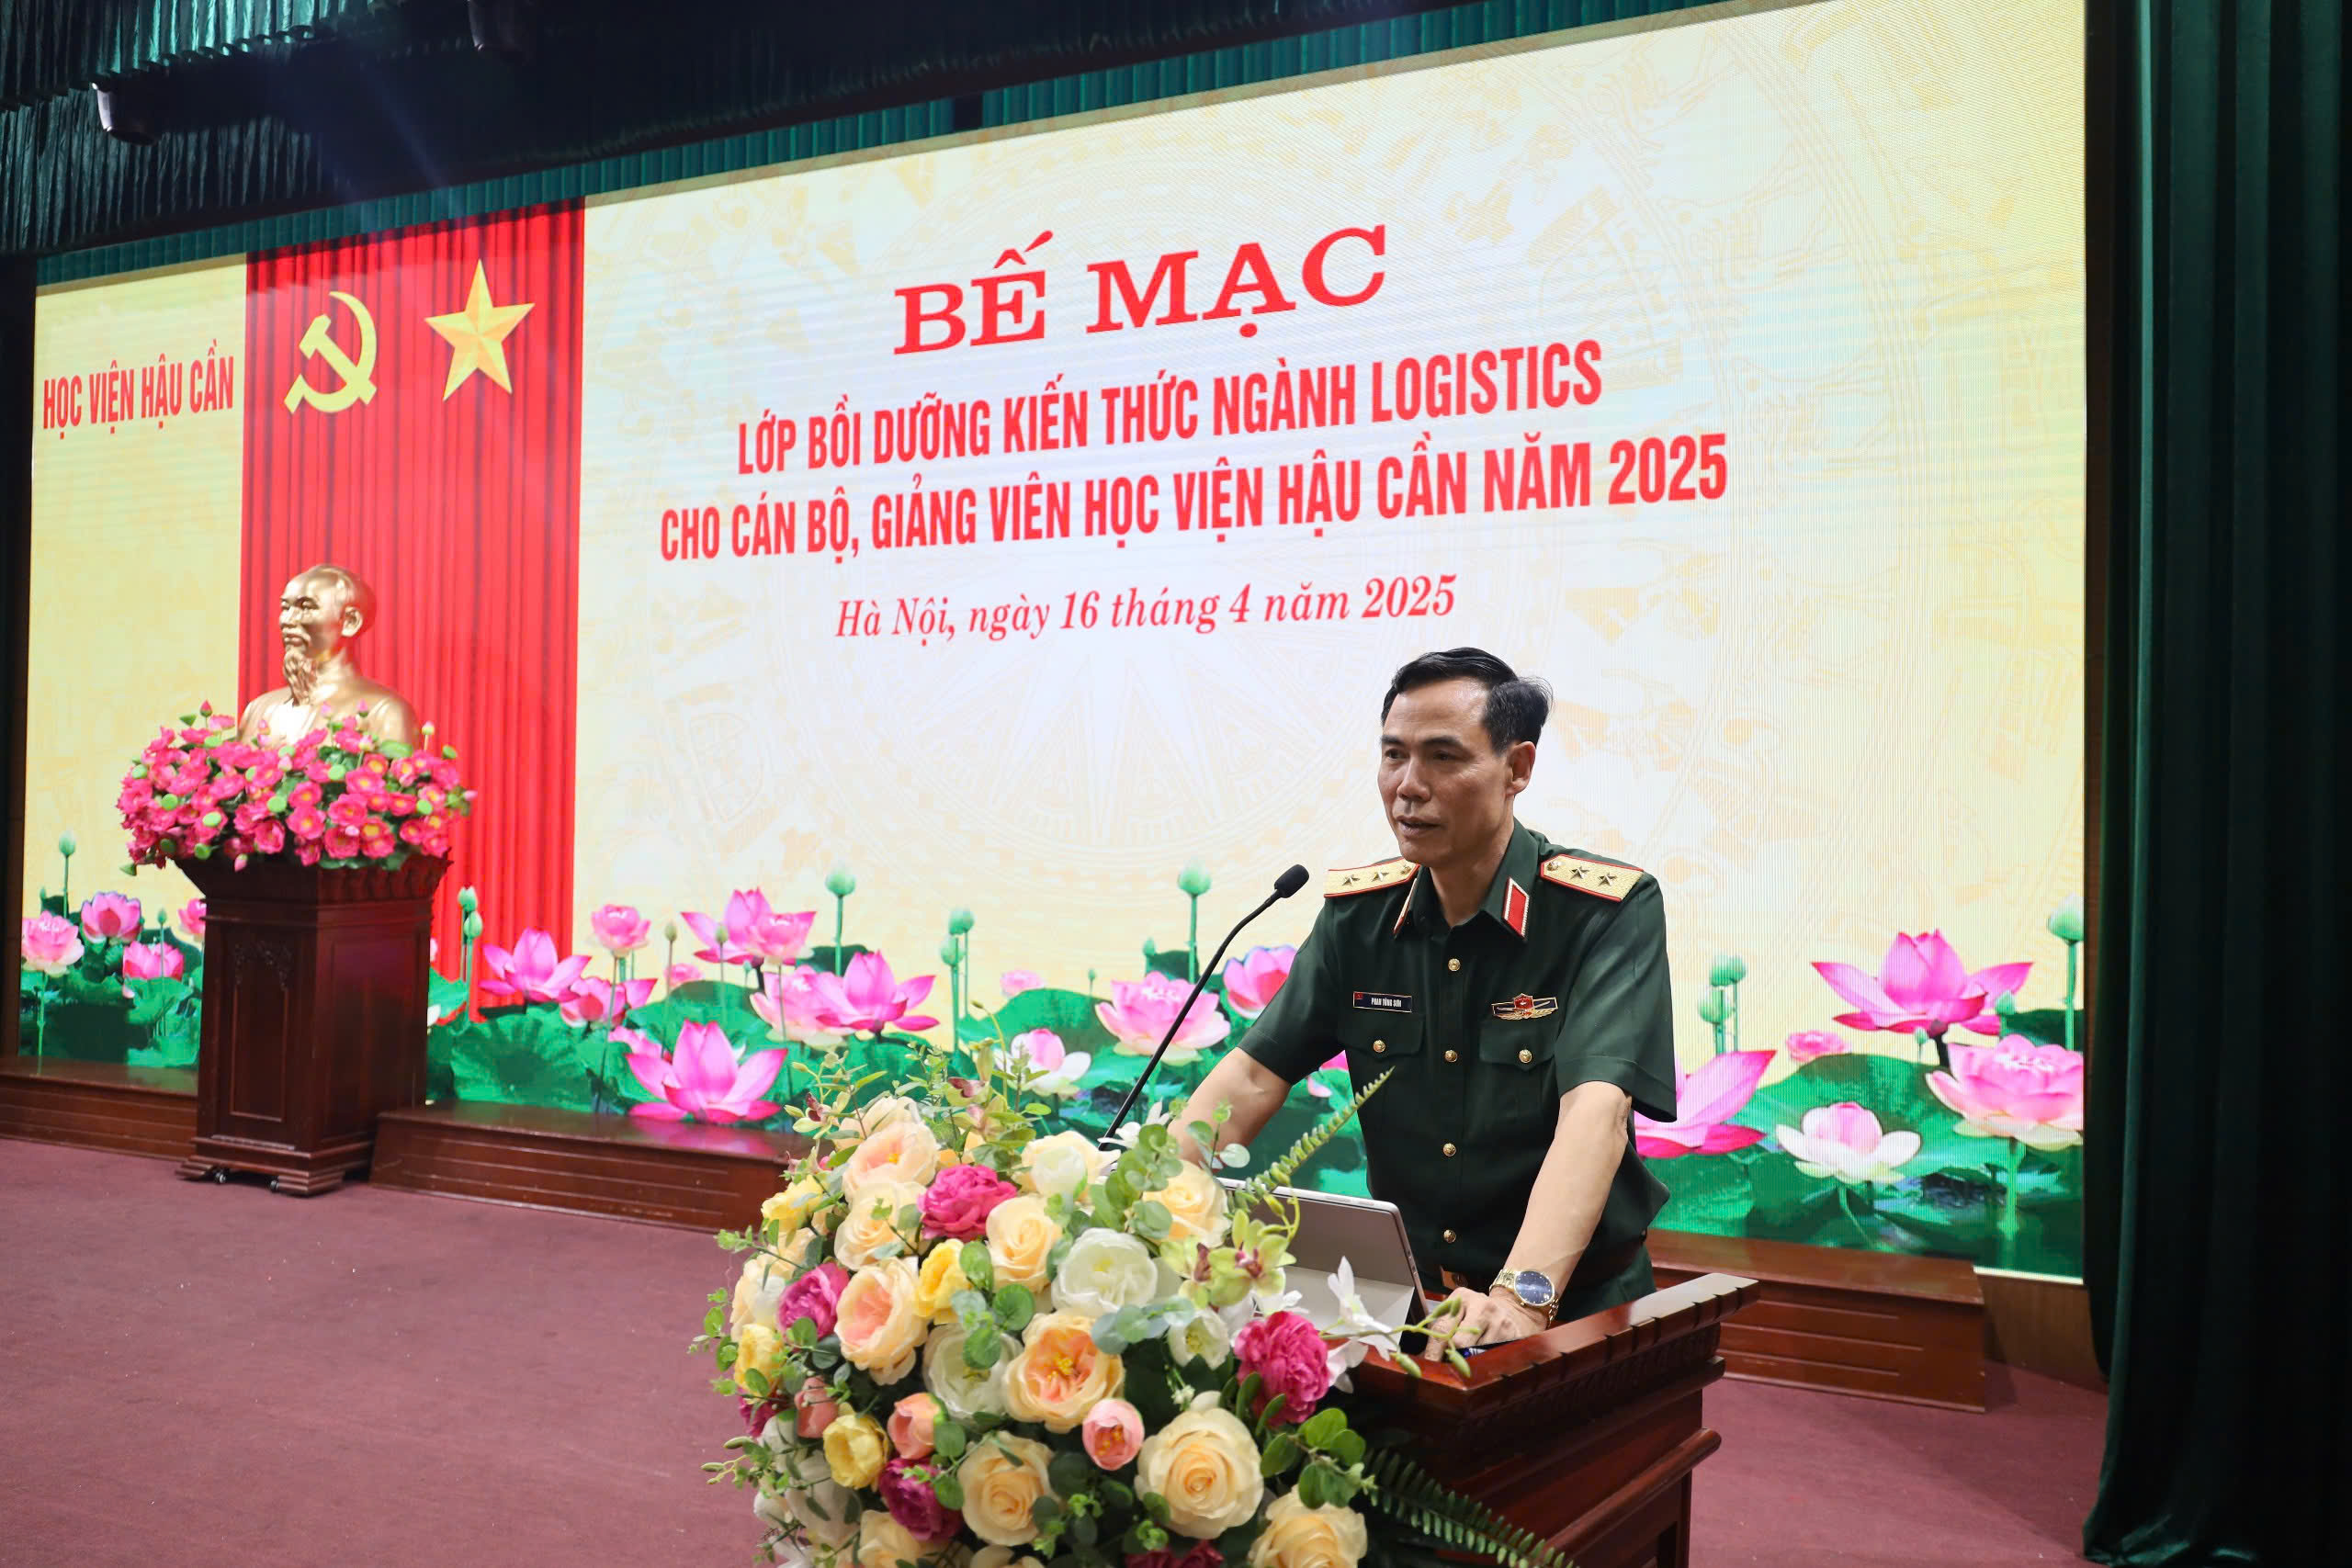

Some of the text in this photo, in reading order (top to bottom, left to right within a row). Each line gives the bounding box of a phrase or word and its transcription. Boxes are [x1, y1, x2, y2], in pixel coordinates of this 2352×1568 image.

[893, 223, 1386, 355] BẾ MẠC
[43, 340, 234, 439] HỌC VIỆN HẬU CẦN
[738, 339, 1602, 476] LỚP BỒI DƯỠNG KIẾN THỨC NGÀNH LOGISTICS
[661, 430, 1728, 565] CHO CÁN BỘ, GIẢNG VIÊN HỌC VIỆN HẬU CẦN NĂM 2025
[837, 574, 1456, 647] Hà Nội, ngày 16 tháng 4 năm 2025
[1371, 997, 1382, 1006] PHAN
